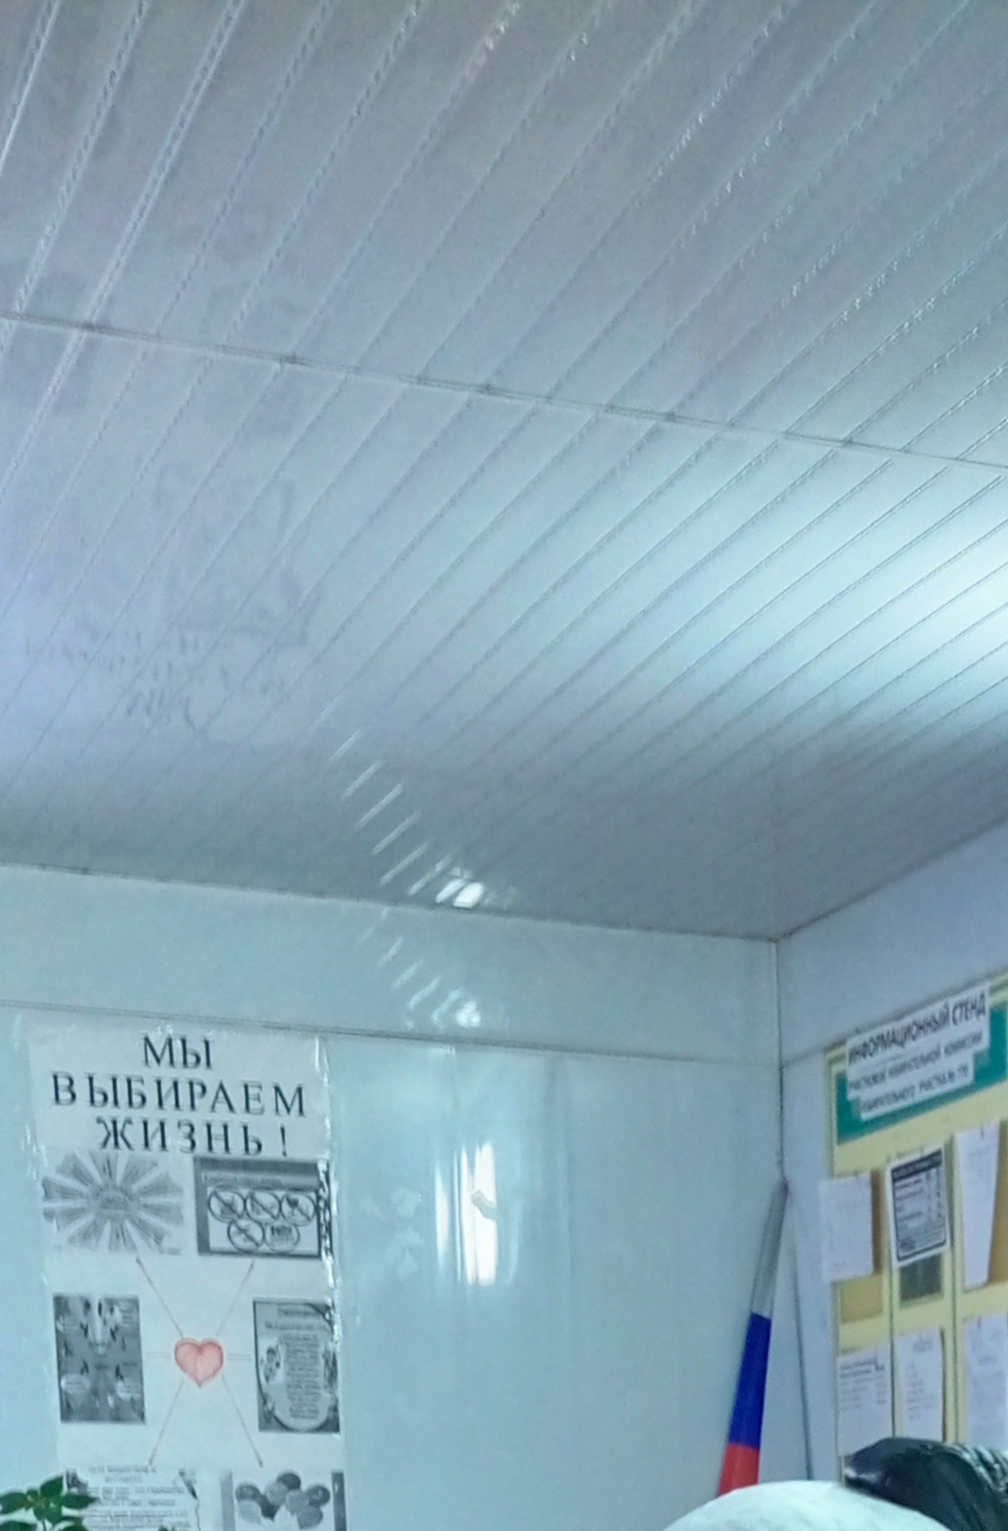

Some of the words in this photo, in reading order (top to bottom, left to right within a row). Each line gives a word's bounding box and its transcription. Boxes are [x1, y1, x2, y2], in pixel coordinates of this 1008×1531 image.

[952, 988, 986, 1026] СТЕНД
[143, 1032, 213, 1069] МЫ
[52, 1070, 306, 1118] ВЫБИРАЕМ
